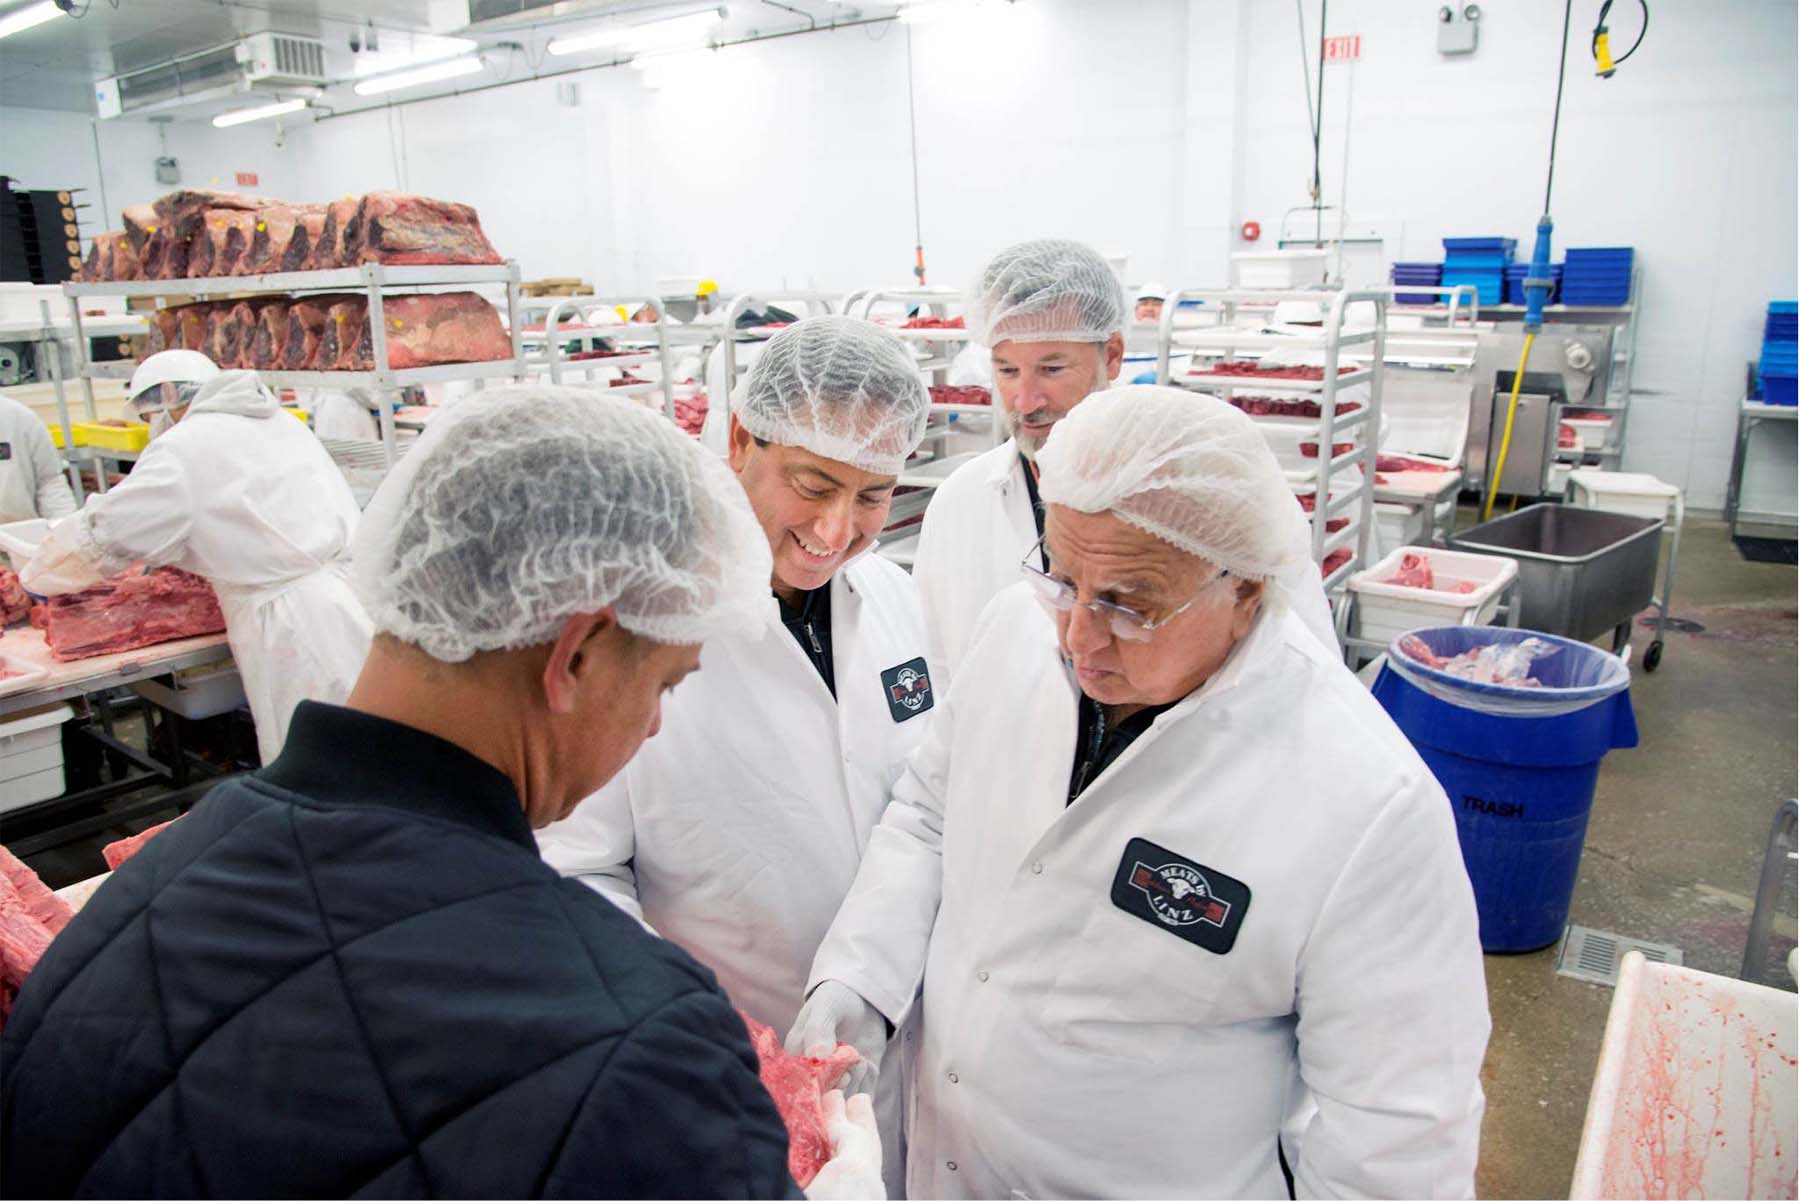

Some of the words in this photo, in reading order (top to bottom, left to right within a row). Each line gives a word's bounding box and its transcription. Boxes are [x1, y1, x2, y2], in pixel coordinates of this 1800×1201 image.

[1462, 794, 1523, 818] TRASH
[1160, 867, 1200, 884] MEATS
[1153, 895, 1194, 921] LINZ
